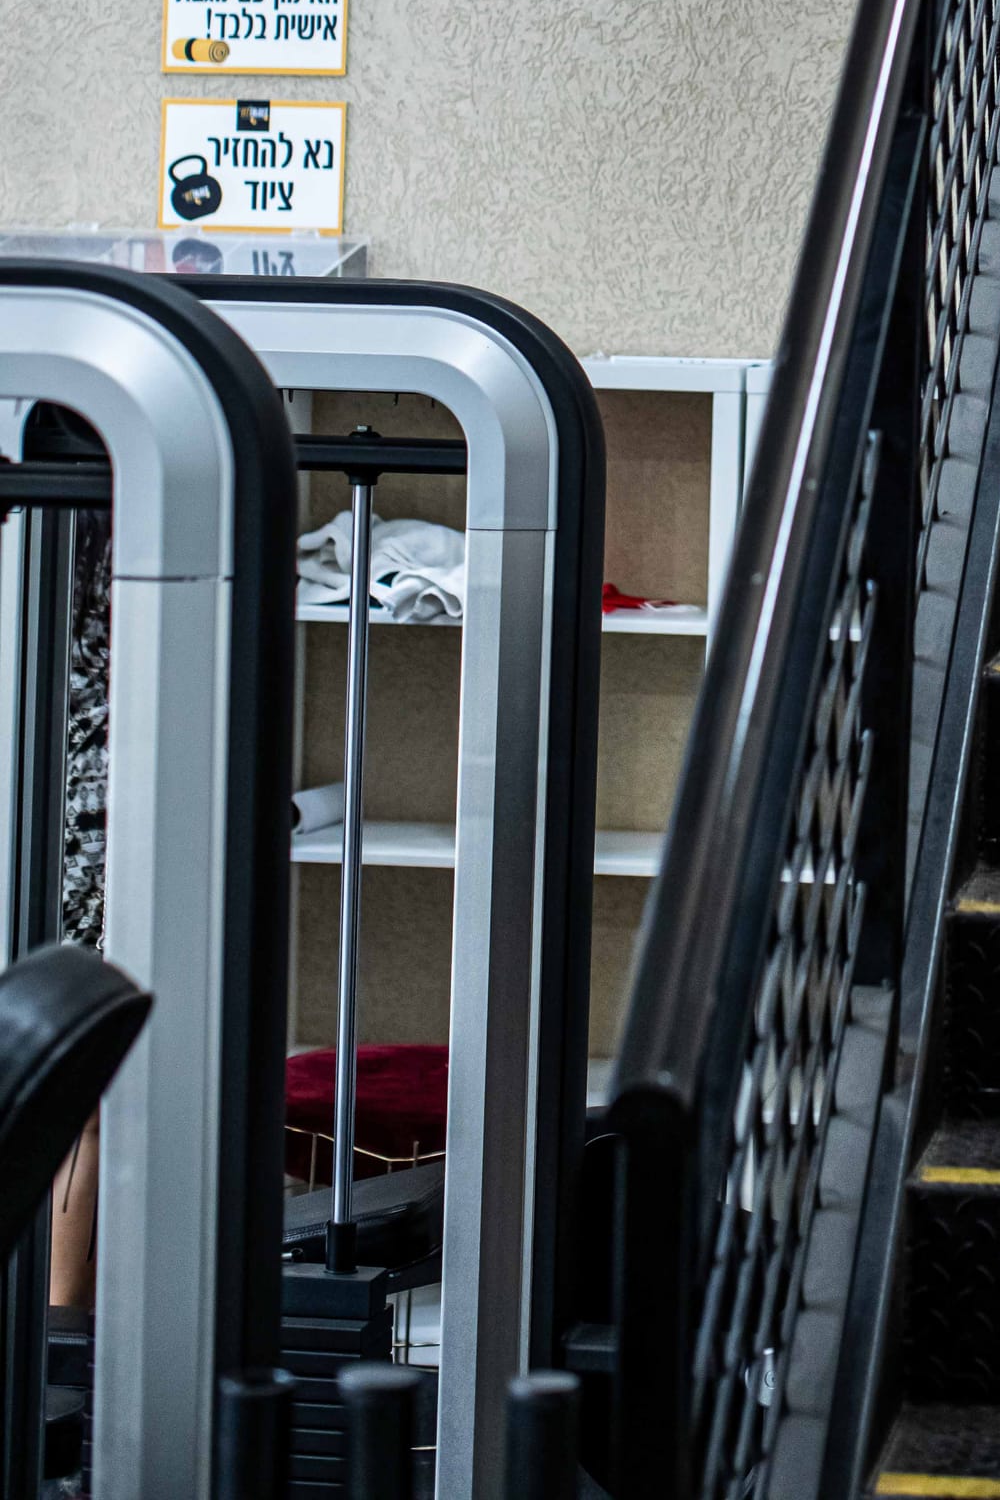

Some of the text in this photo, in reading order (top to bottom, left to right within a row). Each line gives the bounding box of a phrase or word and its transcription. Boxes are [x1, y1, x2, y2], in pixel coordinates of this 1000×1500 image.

[206, 7, 338, 41] אישית בלבד!
[207, 131, 335, 169] נא להחזיר
[244, 180, 294, 211] ציוד
